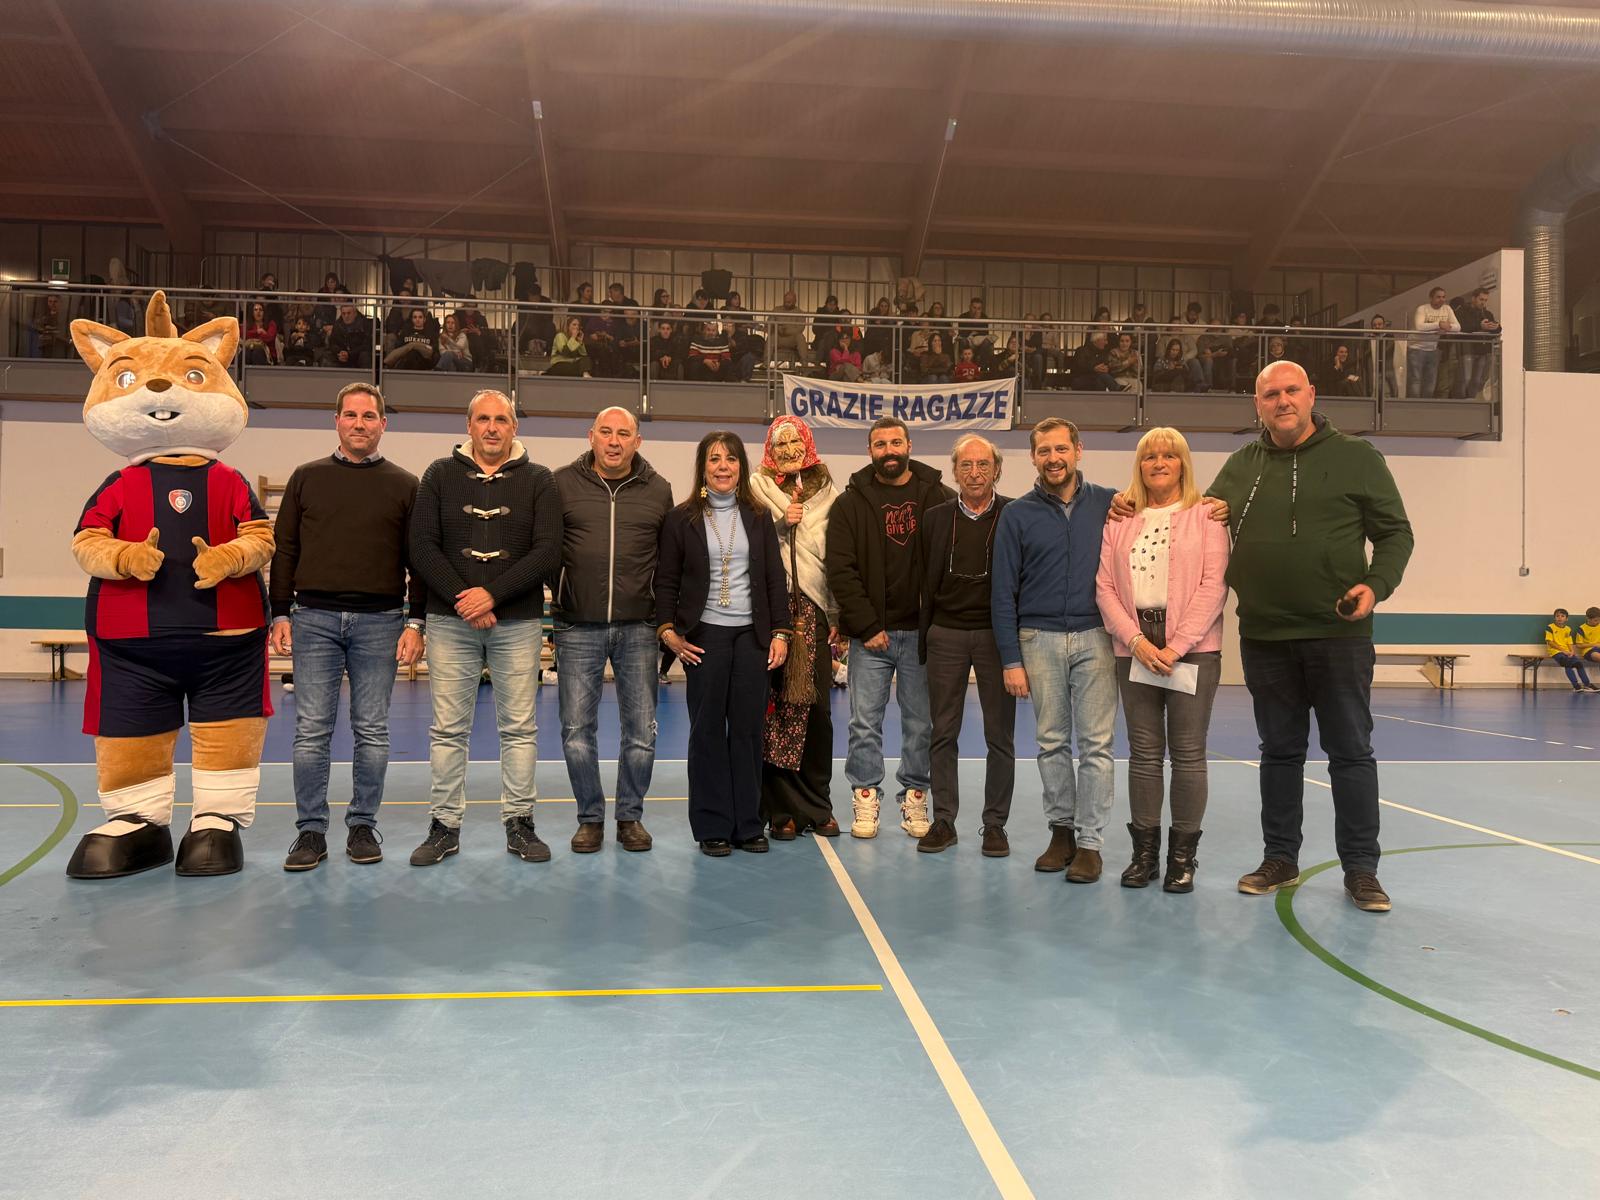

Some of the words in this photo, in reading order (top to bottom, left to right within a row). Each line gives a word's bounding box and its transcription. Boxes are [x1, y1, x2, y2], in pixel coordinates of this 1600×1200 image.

[791, 387, 884, 420] GRAZIE
[892, 390, 1009, 421] RAGAZZE
[886, 524, 905, 535] GIVE
[906, 519, 917, 531] UP
